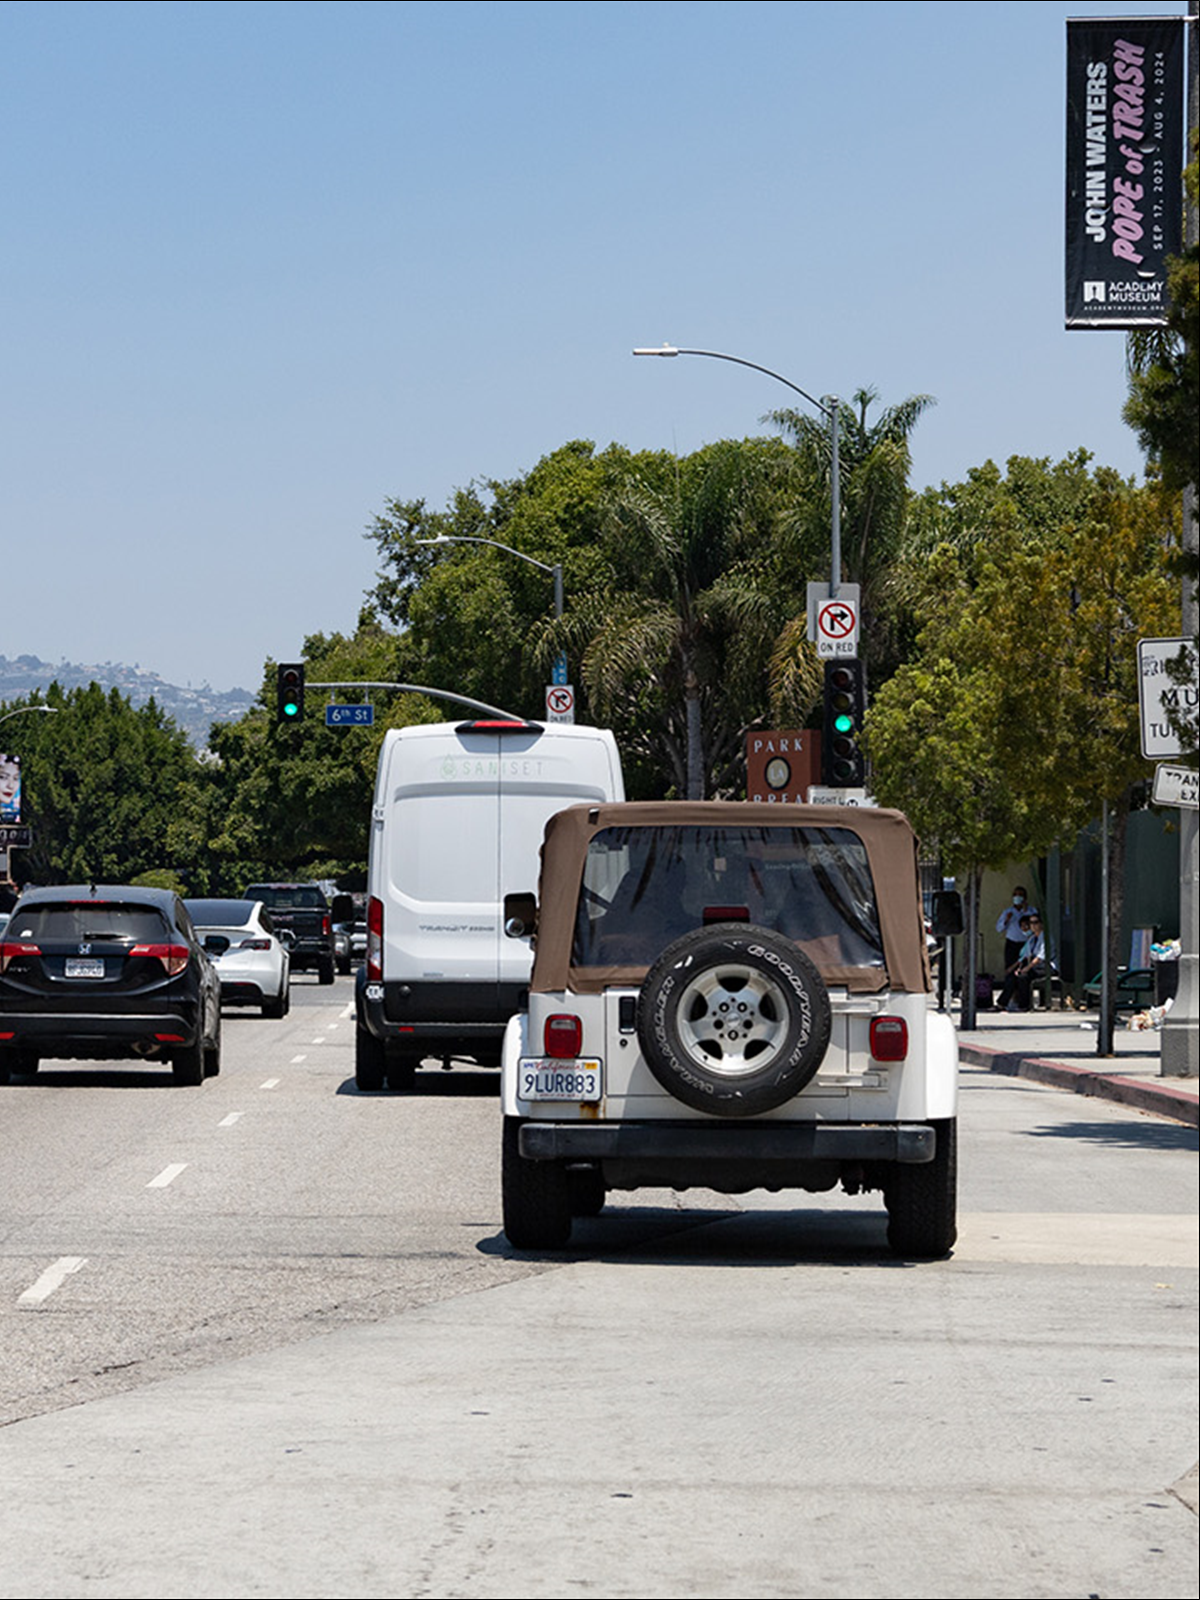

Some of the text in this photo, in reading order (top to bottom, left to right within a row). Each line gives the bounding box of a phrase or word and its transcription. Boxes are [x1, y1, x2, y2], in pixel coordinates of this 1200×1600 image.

[1155, 52, 1164, 84] 2024
[1154, 112, 1163, 139] AUG
[1085, 62, 1107, 242] JOHN WATERS
[1111, 39, 1145, 264] POPE of TRASH
[1153, 160, 1163, 191] 2023
[1153, 225, 1163, 250] SEP
[1109, 292, 1161, 302] MUSEUM
[820, 642, 853, 652] ON RED
[332, 709, 367, 721] 6th St
[754, 739, 803, 753] PARK
[463, 761, 544, 775] SANISET
[769, 768, 785, 780] LA
[748, 944, 812, 1067] GOODYEAR
[525, 1074, 595, 1093] 9LUR883
